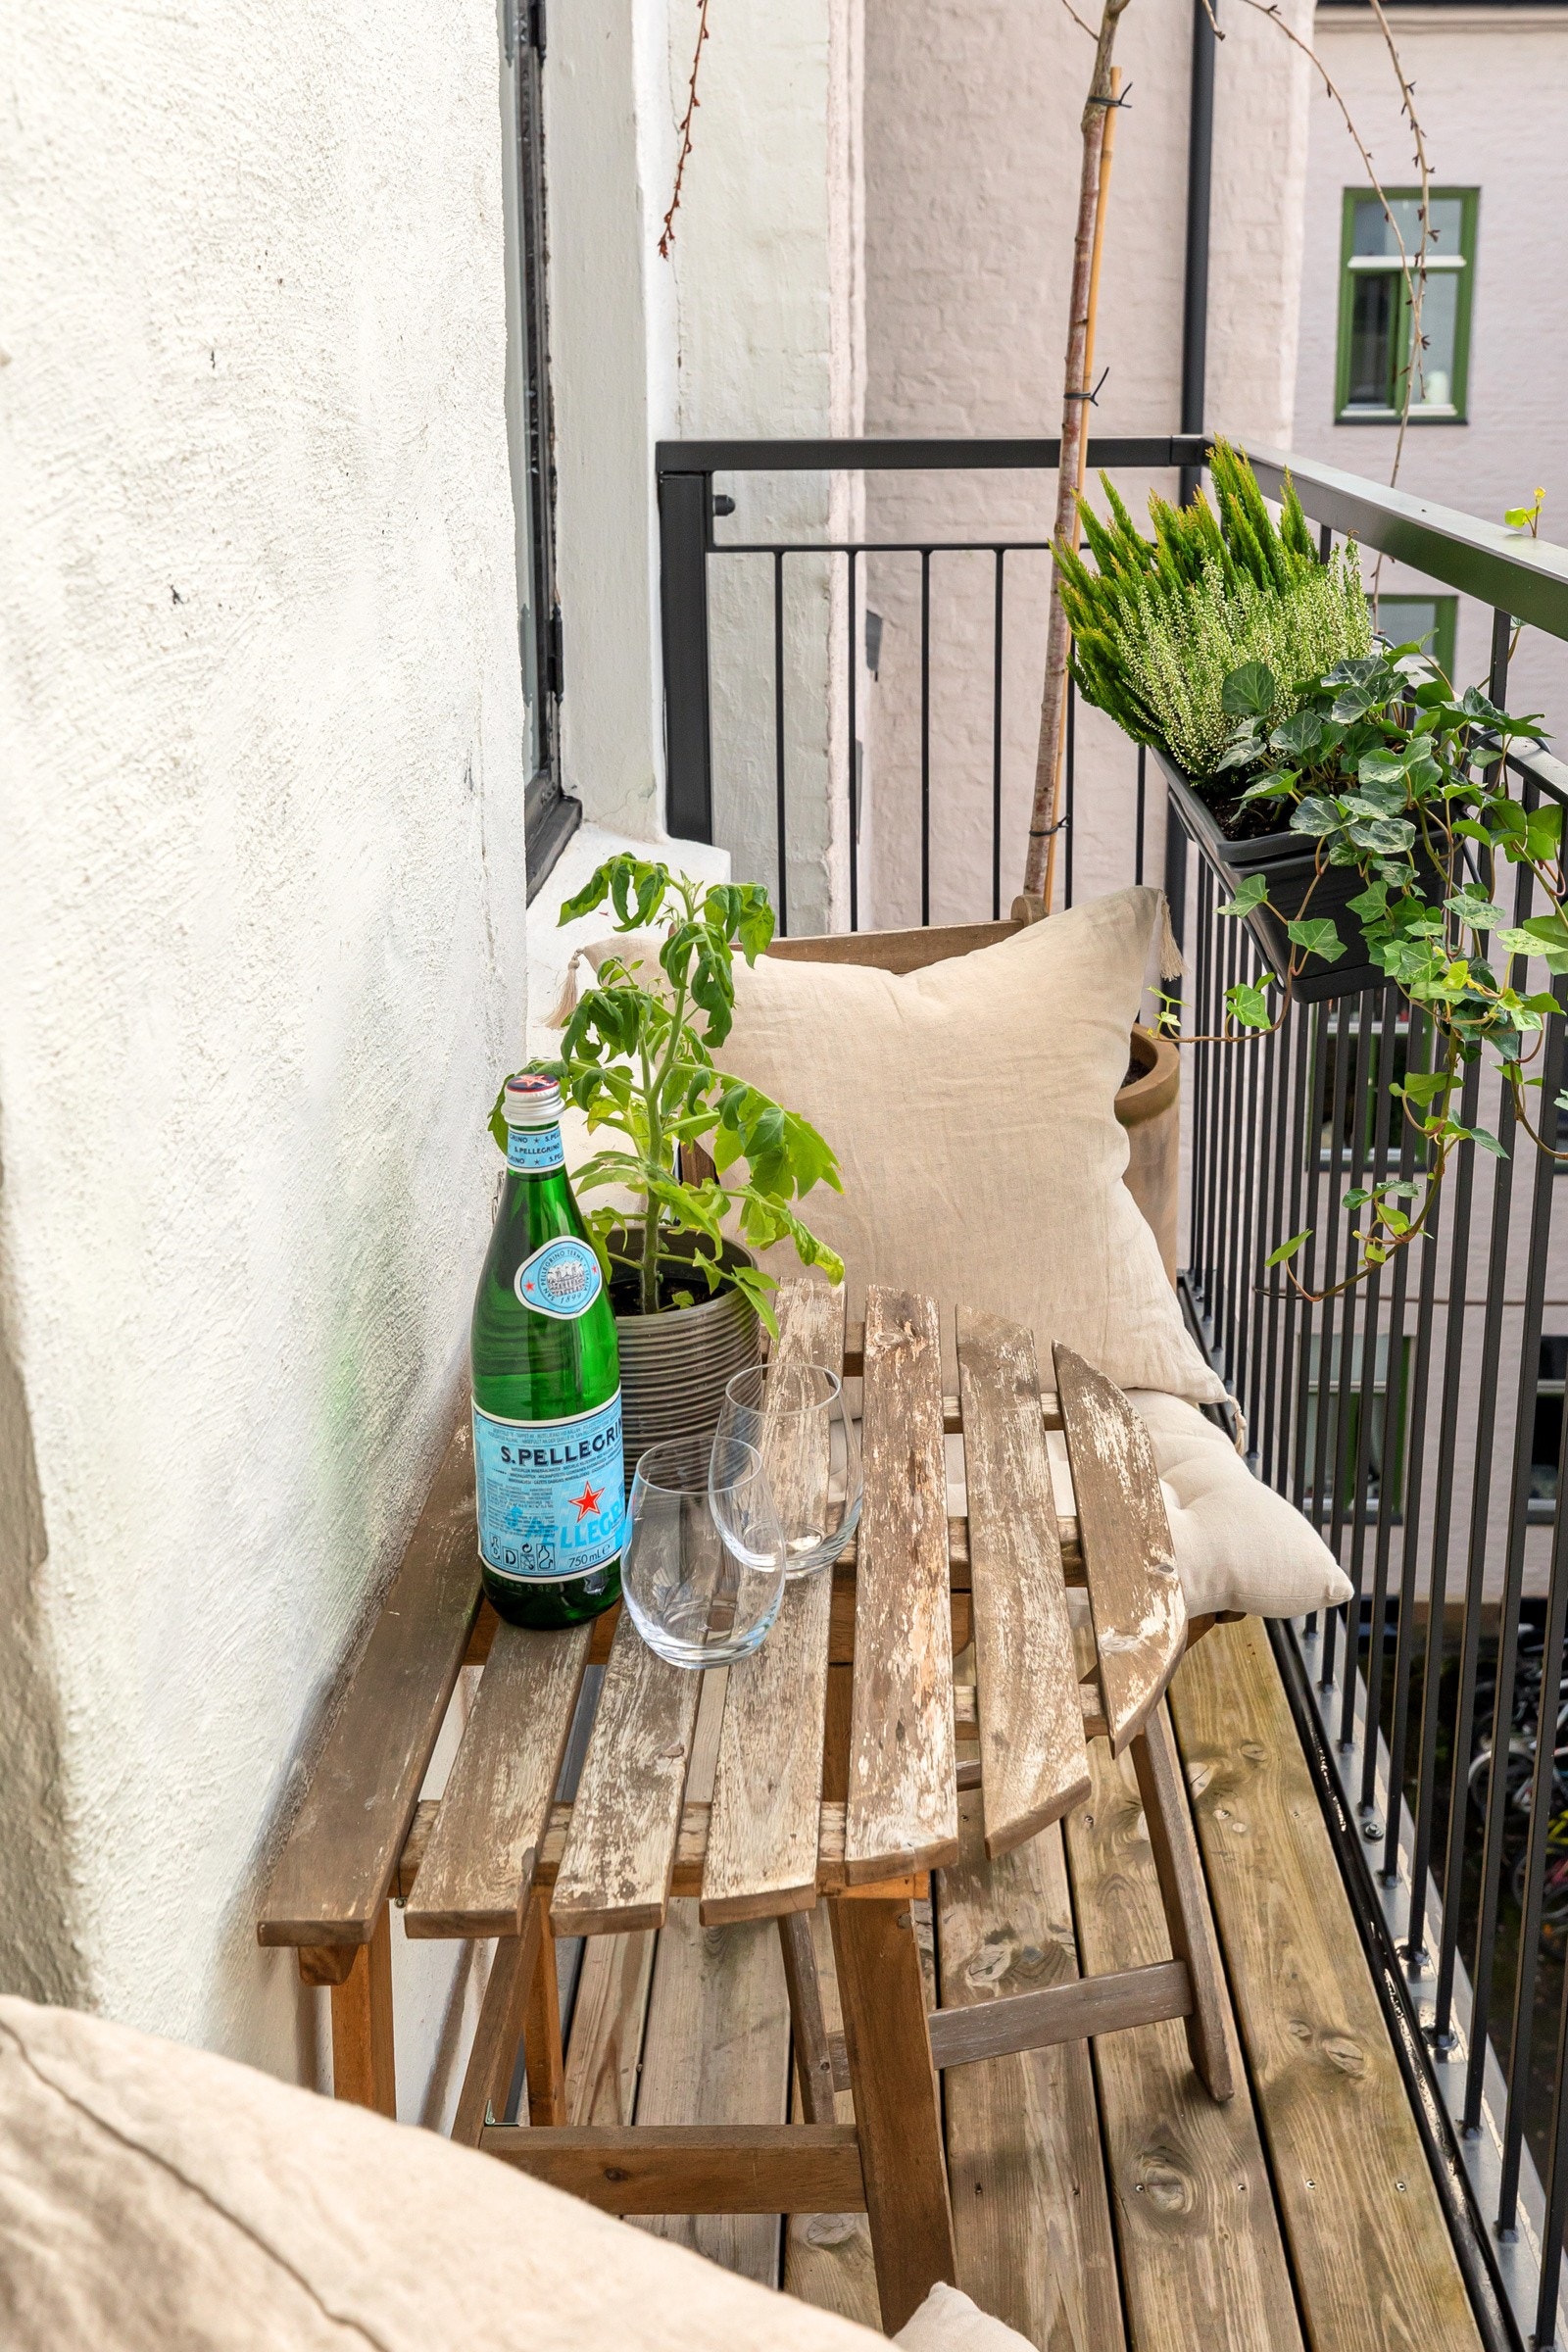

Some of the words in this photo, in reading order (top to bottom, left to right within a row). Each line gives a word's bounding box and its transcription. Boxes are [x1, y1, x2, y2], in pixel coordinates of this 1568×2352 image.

[514, 1143, 560, 1154] S.PELLEGRINO
[561, 1293, 582, 1304] 1899
[568, 1554, 588, 1568] 750
